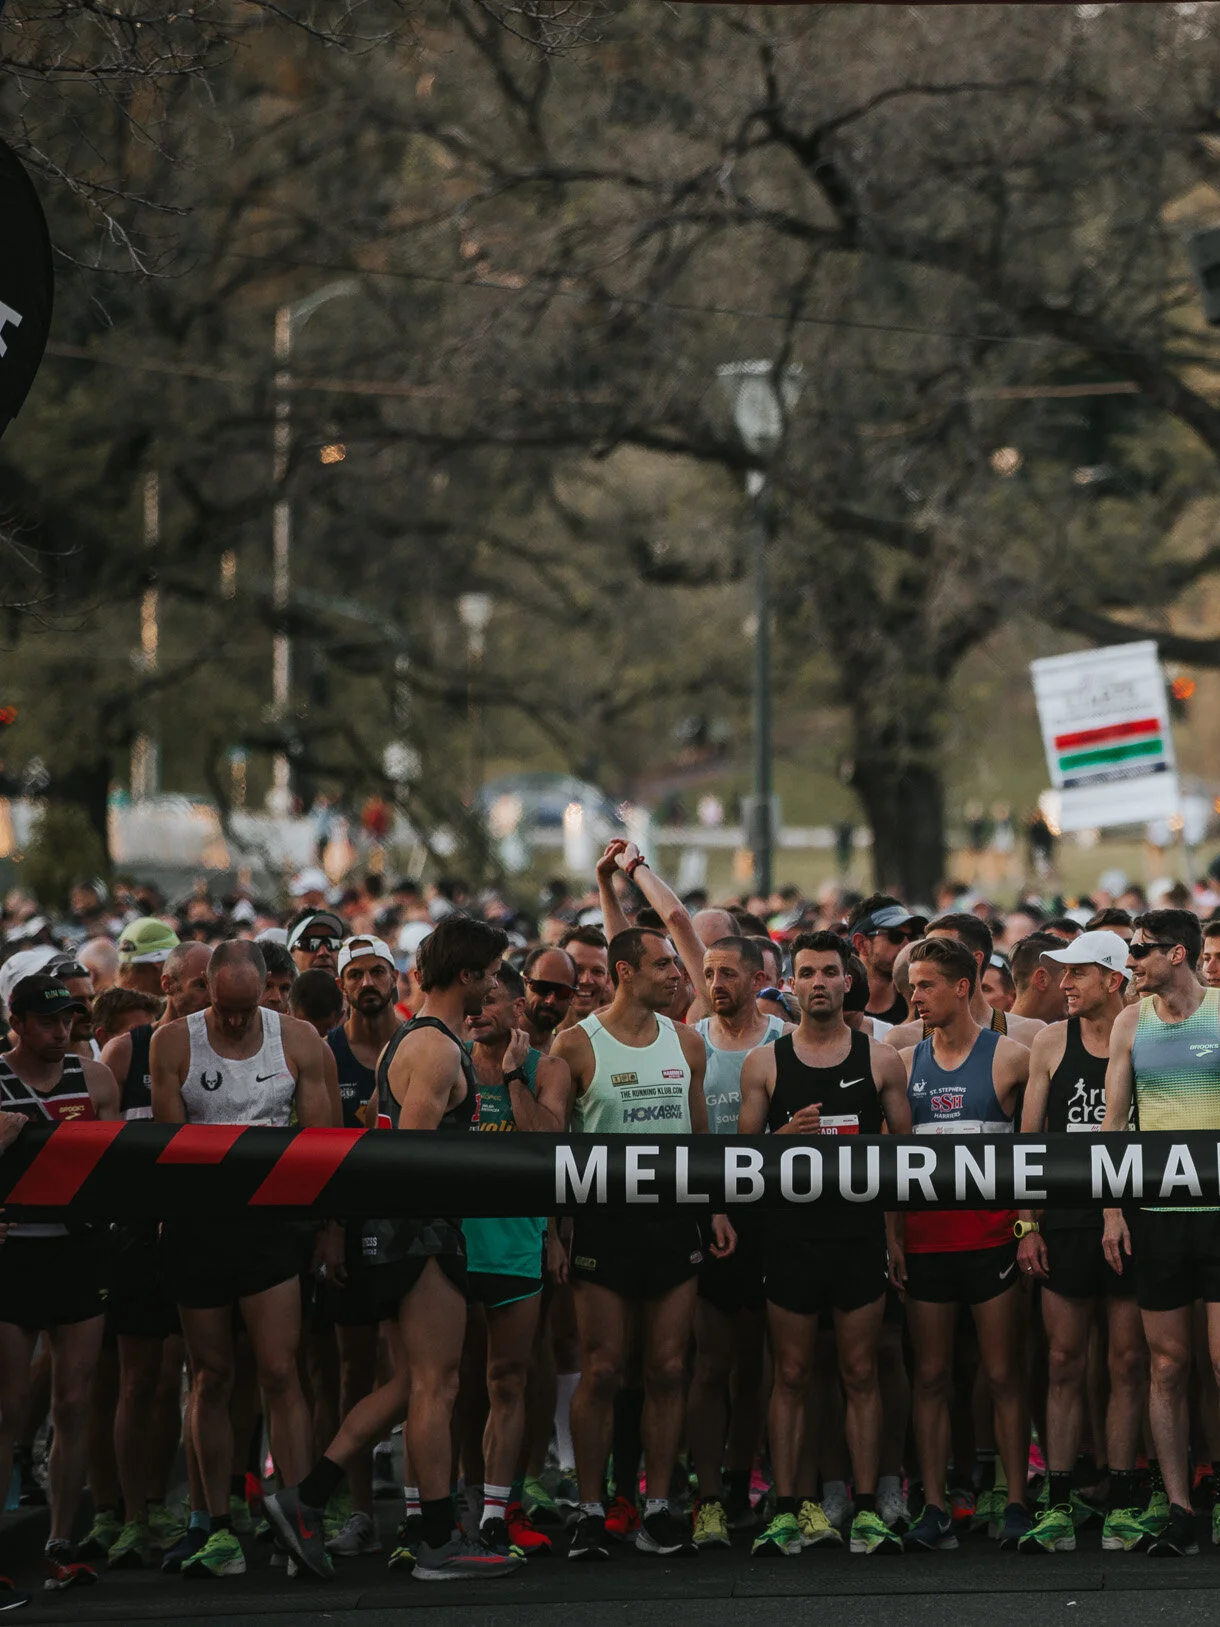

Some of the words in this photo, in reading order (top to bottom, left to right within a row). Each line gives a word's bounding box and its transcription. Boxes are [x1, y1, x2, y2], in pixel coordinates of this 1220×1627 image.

[620, 1090, 632, 1099] THE
[632, 1088, 657, 1097] RUNNING
[657, 1087, 683, 1095] KLUB.COM
[930, 1088, 939, 1096] ST.
[931, 1094, 964, 1112] SSH
[623, 1105, 666, 1123] HOKA
[664, 1104, 682, 1112] ONE
[934, 1111, 961, 1119] HARRIERS
[1068, 1105, 1135, 1123] cre
[555, 1145, 1048, 1204] MELBOURNE
